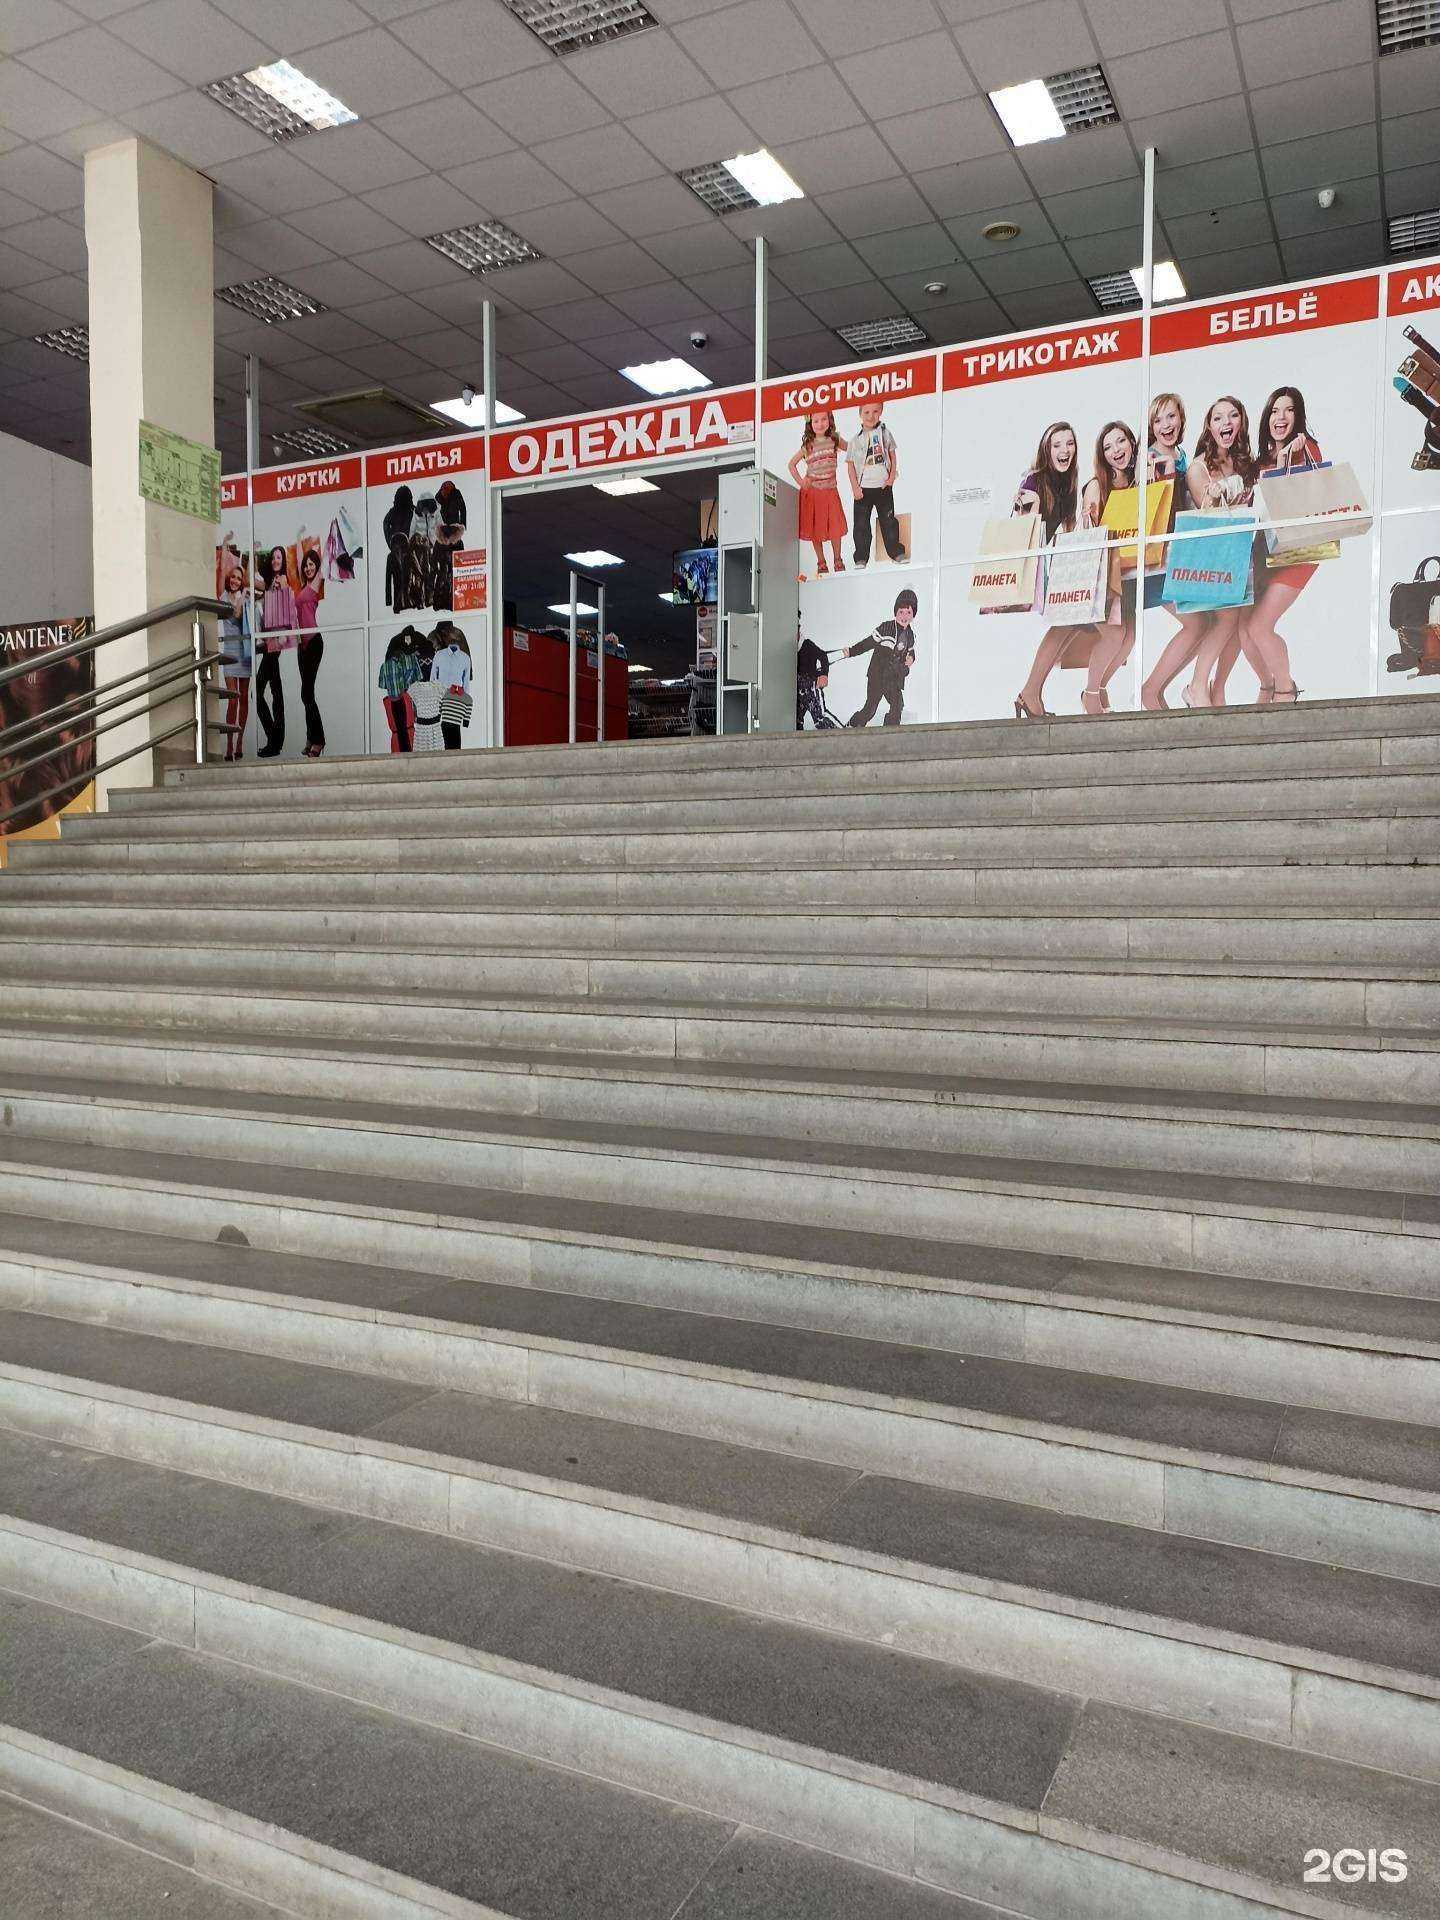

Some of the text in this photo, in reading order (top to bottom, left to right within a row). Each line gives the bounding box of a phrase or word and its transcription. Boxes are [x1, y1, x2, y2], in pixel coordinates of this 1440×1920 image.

[1209, 293, 1318, 336] БЕЛЬЁ
[963, 330, 1120, 378] ТРИКОТАЖ
[783, 369, 914, 412] КОСТЮМЫ
[508, 400, 729, 474] ОДЕЖДА
[386, 447, 462, 476] ПЛАТЬЯ
[276, 467, 341, 493] КУРТКИ
[973, 573, 1017, 586] ПЛАНЕТА
[1171, 567, 1232, 584] ПЛАНЕТА
[1048, 589, 1091, 604] ПЛАНЕТА
